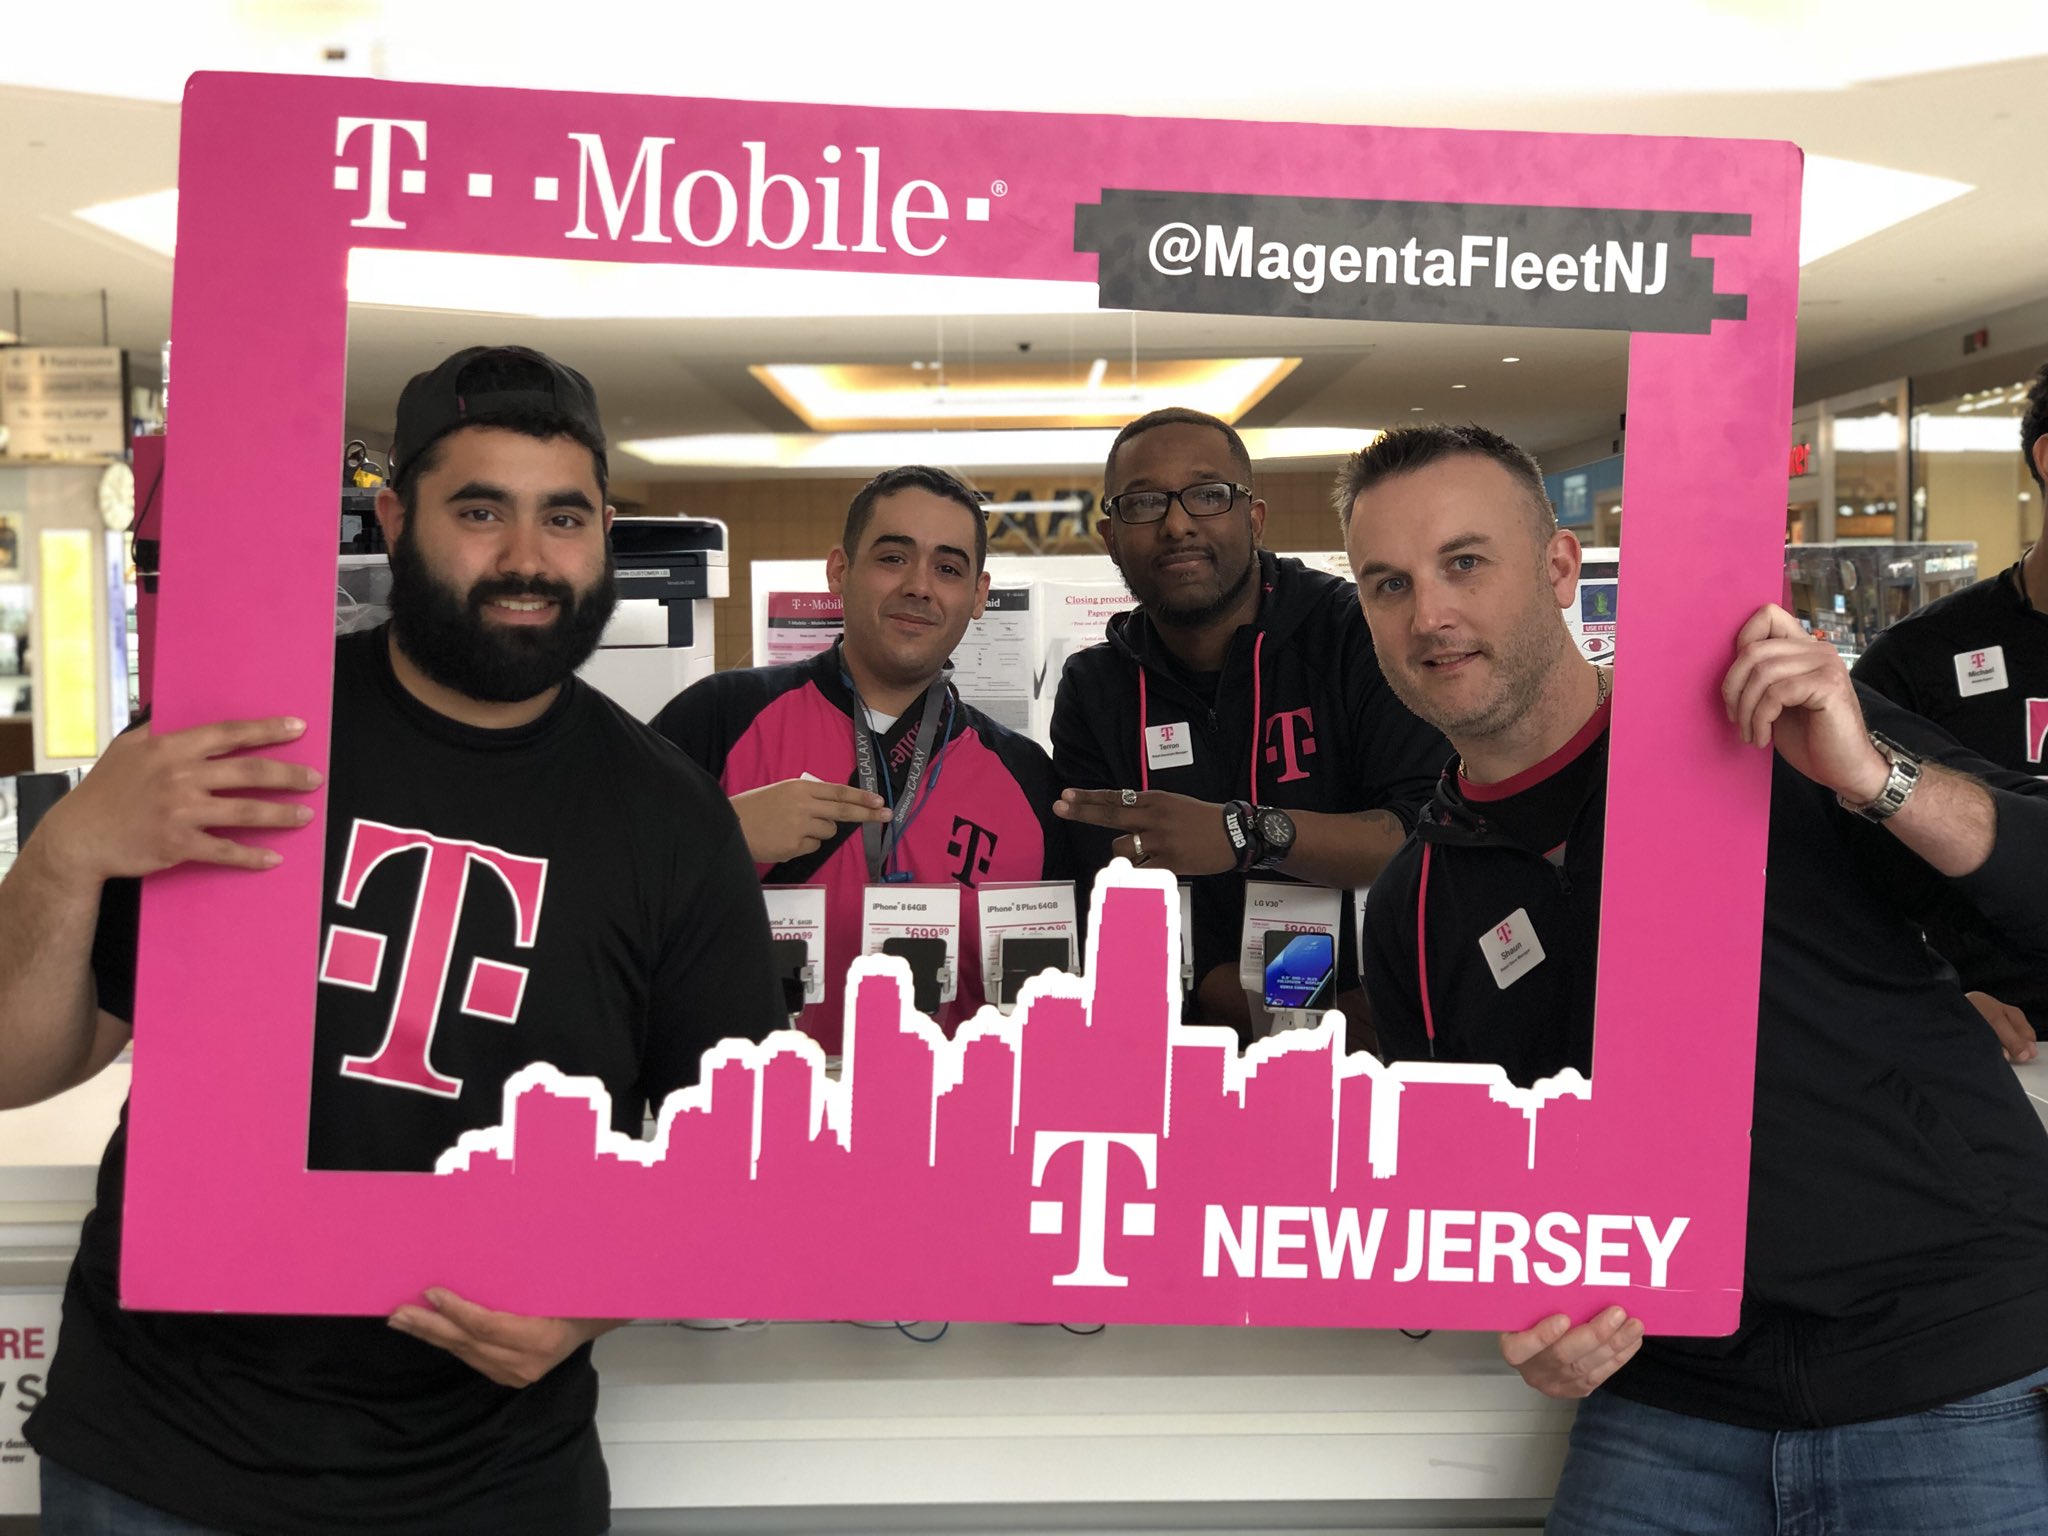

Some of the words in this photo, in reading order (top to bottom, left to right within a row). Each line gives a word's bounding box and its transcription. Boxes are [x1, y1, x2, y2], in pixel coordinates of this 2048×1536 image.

[1147, 220, 1670, 297] @MagentaFleetNJ
[1065, 595, 1099, 605] Closing
[1968, 667, 1995, 678] Michael
[857, 731, 872, 776] GALAXY
[1159, 743, 1180, 751] Terron
[895, 791, 916, 823] Samsung
[908, 747, 926, 793] GALAXY
[1226, 812, 1247, 849] CREATE
[1022, 903, 1037, 911] Plus
[1038, 901, 1058, 910] 64GB
[1500, 942, 1523, 961] Shaun
[1202, 1204, 1389, 1281] NEW
[1394, 1208, 1691, 1289] JERSEY
